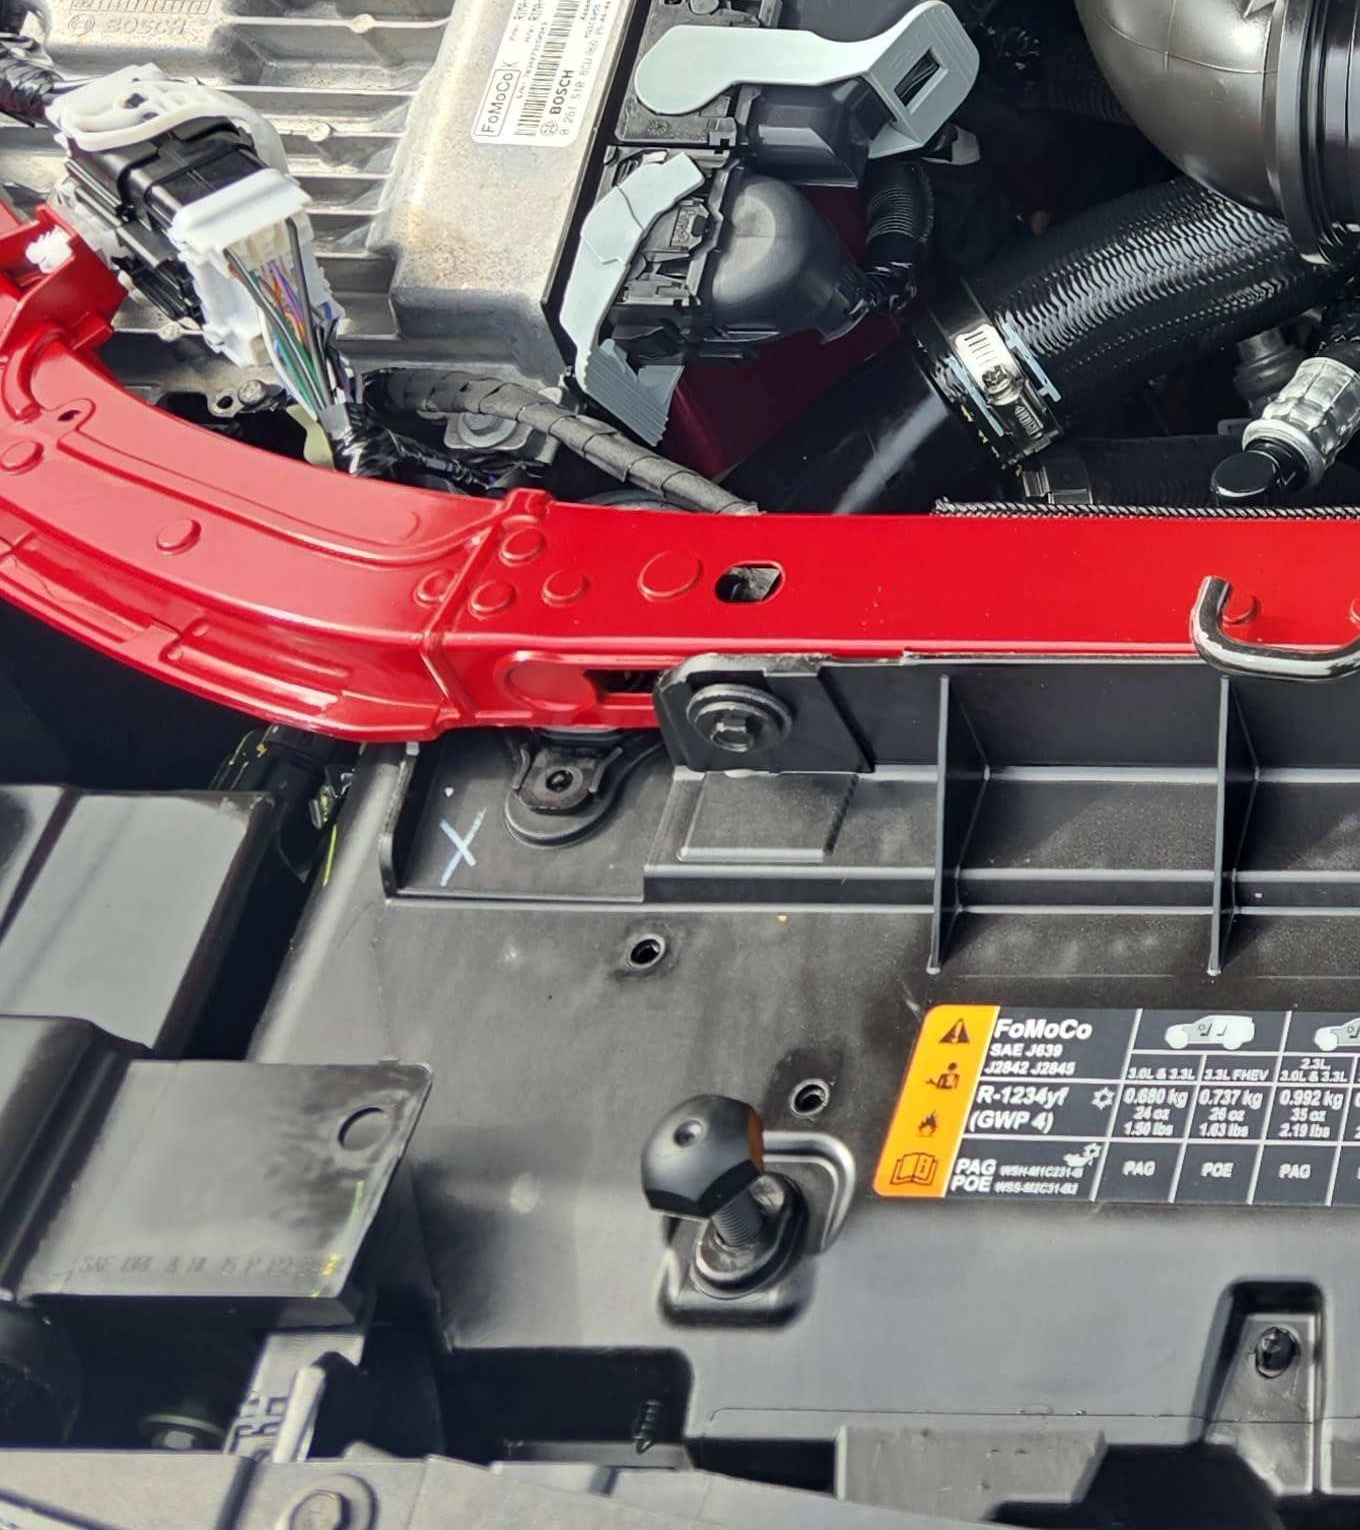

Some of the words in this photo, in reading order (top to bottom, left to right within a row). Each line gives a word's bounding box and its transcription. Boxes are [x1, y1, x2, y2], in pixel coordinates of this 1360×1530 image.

[549, 69, 576, 115] BOSCH
[482, 71, 514, 134] FoMoCo
[993, 1017, 1093, 1040] FoMoCo
[989, 1043, 1024, 1058] SAE
[1025, 1043, 1064, 1058] J639
[983, 1061, 1030, 1075] J2842
[1030, 1061, 1077, 1076] J2845
[1127, 1067, 1155, 1081] 3.0L
[1155, 1068, 1168, 1080] &
[1168, 1067, 1196, 1081] 3.3L
[1203, 1068, 1231, 1081] 3.3L
[1232, 1068, 1270, 1082] FHEV
[1280, 1070, 1308, 1083] 3.0L
[1309, 1071, 1320, 1083] &
[1320, 1071, 1349, 1084] 3.3L
[975, 1085, 1071, 1110] R-1234yf
[1123, 1087, 1166, 1105] 0.680
[1167, 1087, 1189, 1109] kg
[1198, 1088, 1241, 1106] 0.737
[1241, 1088, 1264, 1111] kg
[1279, 1089, 1322, 1107] 0.992
[1323, 1089, 1345, 1111] kg
[1132, 1106, 1152, 1121] 24
[1152, 1108, 1171, 1121] oz
[1207, 1107, 1228, 1122] 26
[1228, 1109, 1247, 1122] oz
[1289, 1108, 1308, 1122] 35
[1308, 1110, 1327, 1122] oz
[967, 1110, 1031, 1133] (GWP
[1031, 1111, 1055, 1134] 4)
[1123, 1121, 1152, 1137] 1.50
[1152, 1121, 1174, 1137] lbs
[1199, 1122, 1228, 1138] 1.63
[1227, 1122, 1249, 1138] lbs
[1278, 1124, 1309, 1138] 2.19
[1309, 1124, 1331, 1139] lbs
[954, 1157, 998, 1176] PAG
[1122, 1160, 1157, 1177] PAG
[1200, 1161, 1235, 1179] POE
[1278, 1163, 1312, 1179] PAG
[950, 1175, 995, 1193] POE
